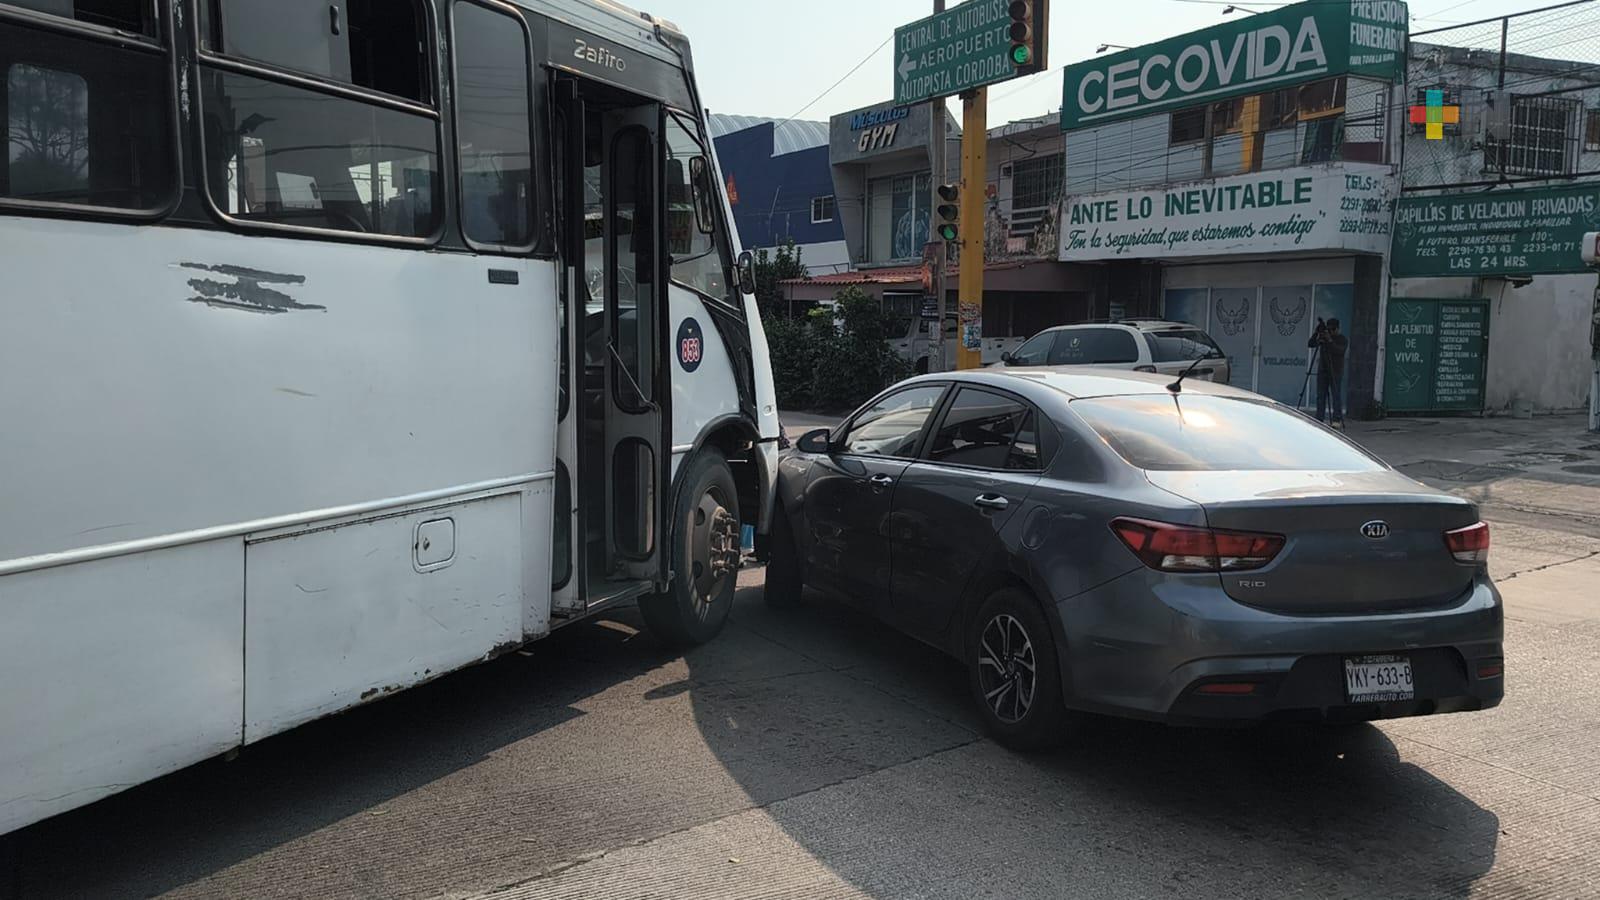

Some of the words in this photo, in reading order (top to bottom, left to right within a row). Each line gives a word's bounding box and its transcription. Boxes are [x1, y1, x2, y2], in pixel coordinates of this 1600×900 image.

[901, 25, 936, 54] CENTRAL
[940, 19, 951, 40] DE
[919, 24, 1011, 70] AEROPUERTO
[900, 70, 951, 101] AUTOPISTA
[956, 52, 1010, 86] CORDOBA
[1078, 16, 1327, 113] CECOVIDA
[858, 123, 899, 152] GYM
[1070, 200, 1118, 225] ANTE
[1127, 196, 1152, 220] LO
[1165, 177, 1313, 217] INEVITABLE
[1451, 204, 1464, 221] DE
[1469, 200, 1526, 219] VELACION
[1065, 229, 1086, 251] Ten
[1090, 227, 1101, 248] la
[1168, 229, 1189, 250] que
[1192, 223, 1255, 243] estaremos
[1450, 257, 1471, 269] LAS
[1481, 256, 1498, 268] 24
[1504, 255, 1529, 267] HRS.
[1389, 324, 1400, 334] LA
[681, 337, 700, 363] 853
[1405, 338, 1416, 348] DE
[1395, 352, 1423, 363] VIVIR.
[1367, 525, 1388, 536] KIA
[1347, 665, 1412, 688] YKY-633-B
